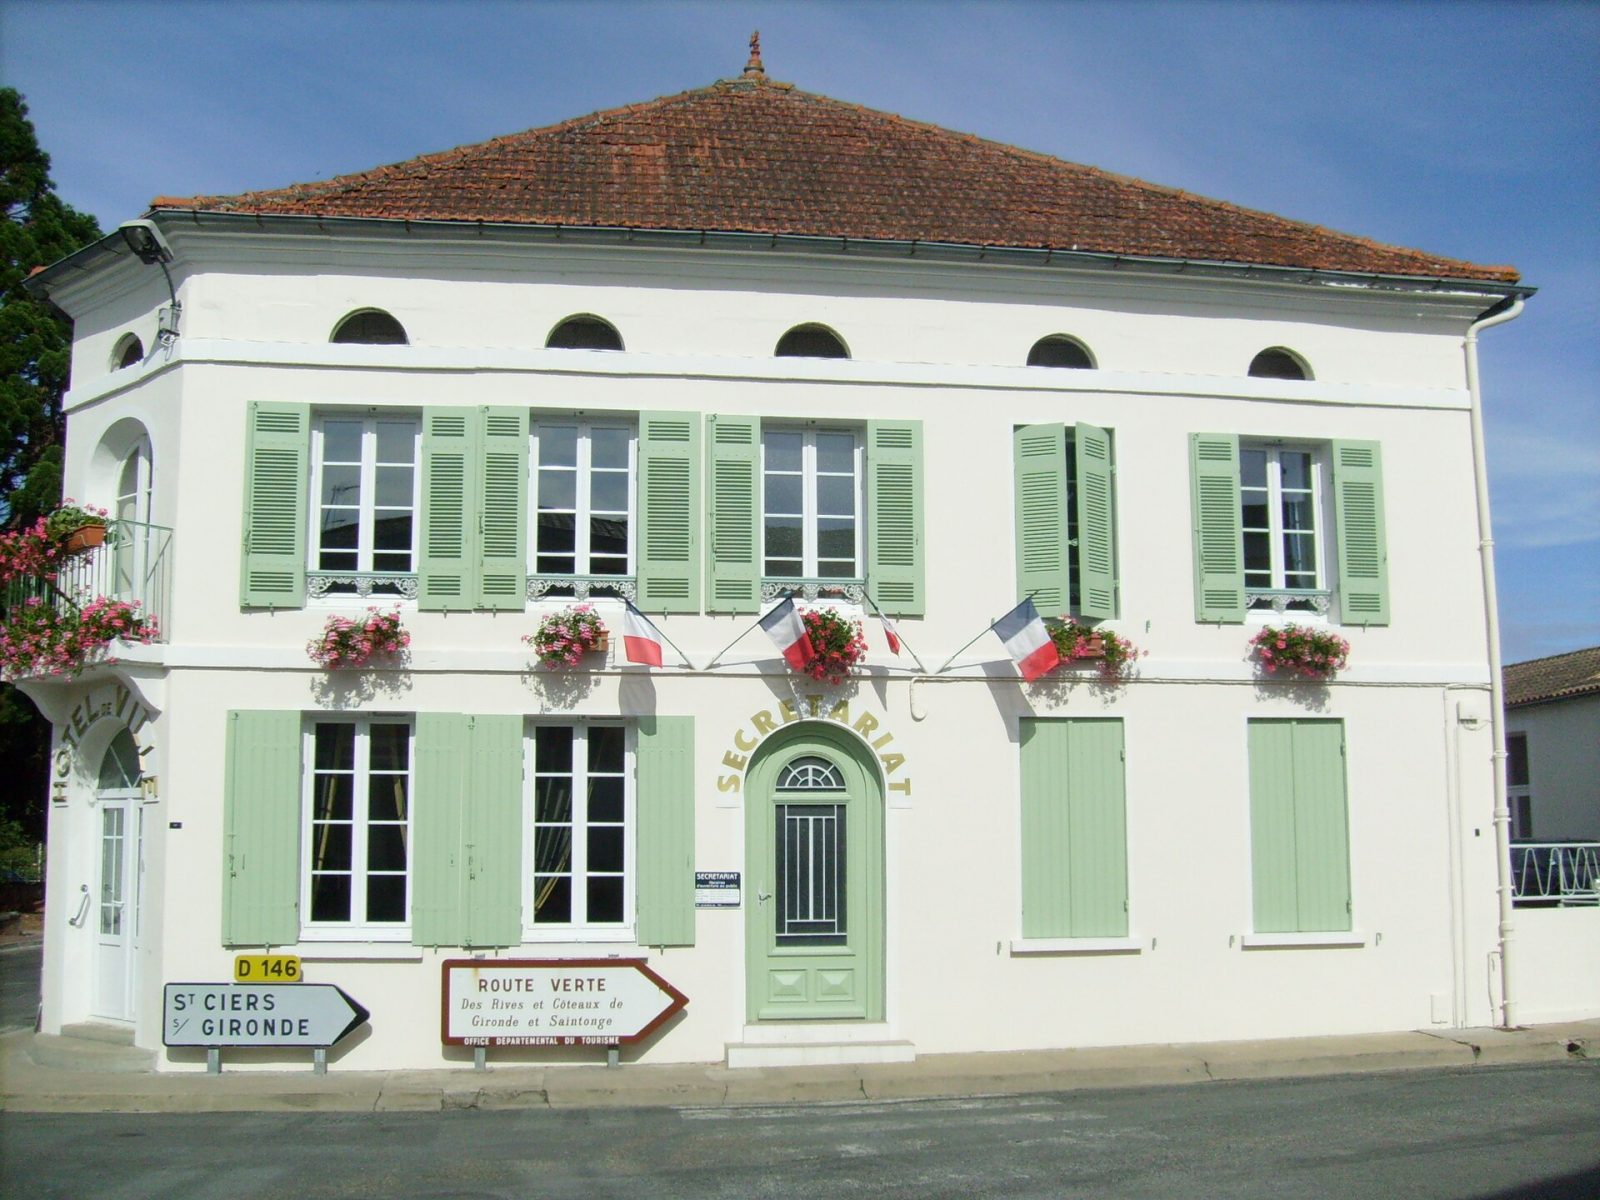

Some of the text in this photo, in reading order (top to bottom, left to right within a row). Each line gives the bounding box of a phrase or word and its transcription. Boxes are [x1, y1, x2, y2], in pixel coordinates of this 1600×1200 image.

[717, 694, 911, 796] SECRETARIAT
[238, 959, 297, 977] D 146
[478, 978, 606, 992] ROUTE VERTE
[204, 994, 275, 1011] CIERS
[461, 998, 482, 1010] Des
[491, 998, 524, 1010] Rives
[533, 1000, 544, 1010] et
[609, 997, 624, 1009] de
[202, 1019, 309, 1036] GIRONDE
[471, 1014, 613, 1030] Gironde et Saintonge
[464, 1037, 490, 1046] OFFICE
[564, 1036, 575, 1045] DU
[581, 1036, 620, 1045] TOURISME
